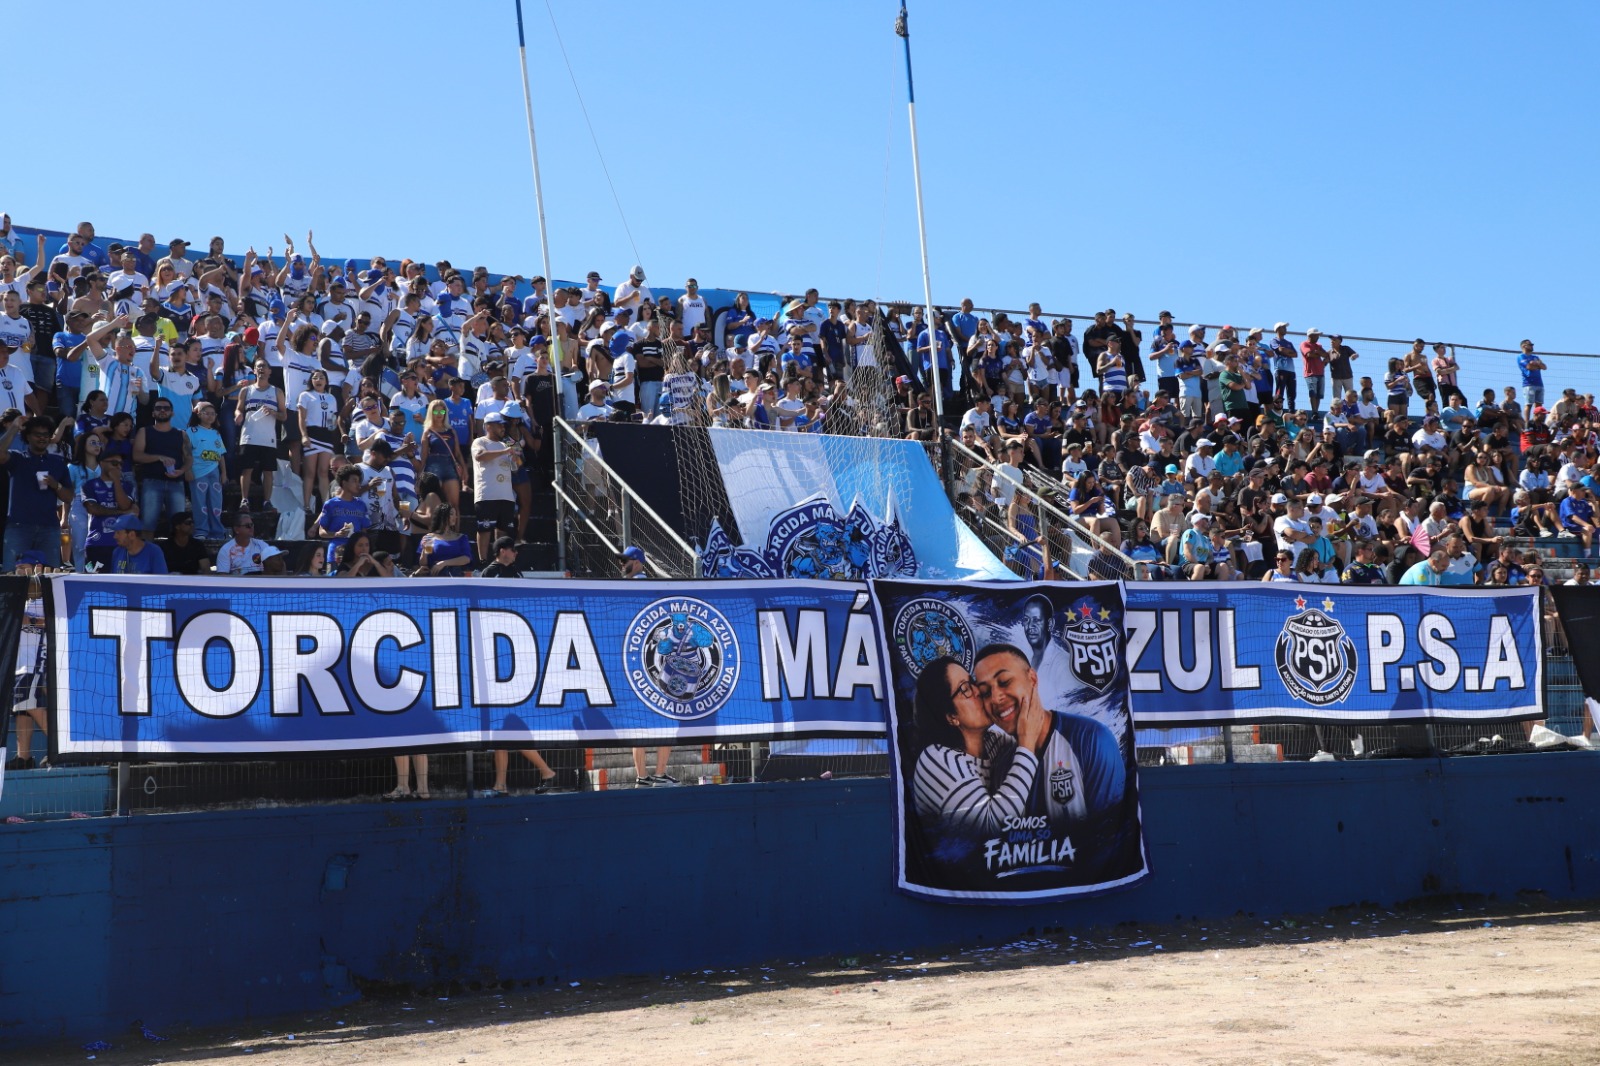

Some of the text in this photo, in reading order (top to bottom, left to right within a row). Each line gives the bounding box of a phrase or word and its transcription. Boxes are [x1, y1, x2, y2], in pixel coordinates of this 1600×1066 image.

[769, 511, 809, 558] ORCIDA
[879, 528, 894, 575] ORCIDA
[629, 601, 732, 652] TORCIDA MÁFIA AZUL
[897, 601, 969, 642] TORCIDA MÁFIA AZUL
[90, 606, 614, 718] TORCIDA
[1126, 608, 1261, 693] ZUL
[1367, 613, 1526, 693] P.S.A
[898, 645, 922, 674] PARQU
[1072, 641, 1117, 676] PSA
[1294, 634, 1338, 681] PSA
[632, 669, 693, 713] QUEBRADA
[695, 666, 735, 711] QUERIDA
[1052, 779, 1073, 798] PSA
[1001, 815, 1048, 832] SOMOS
[1008, 830, 1033, 843] UMA
[984, 835, 1077, 870] FAMÍLIA
